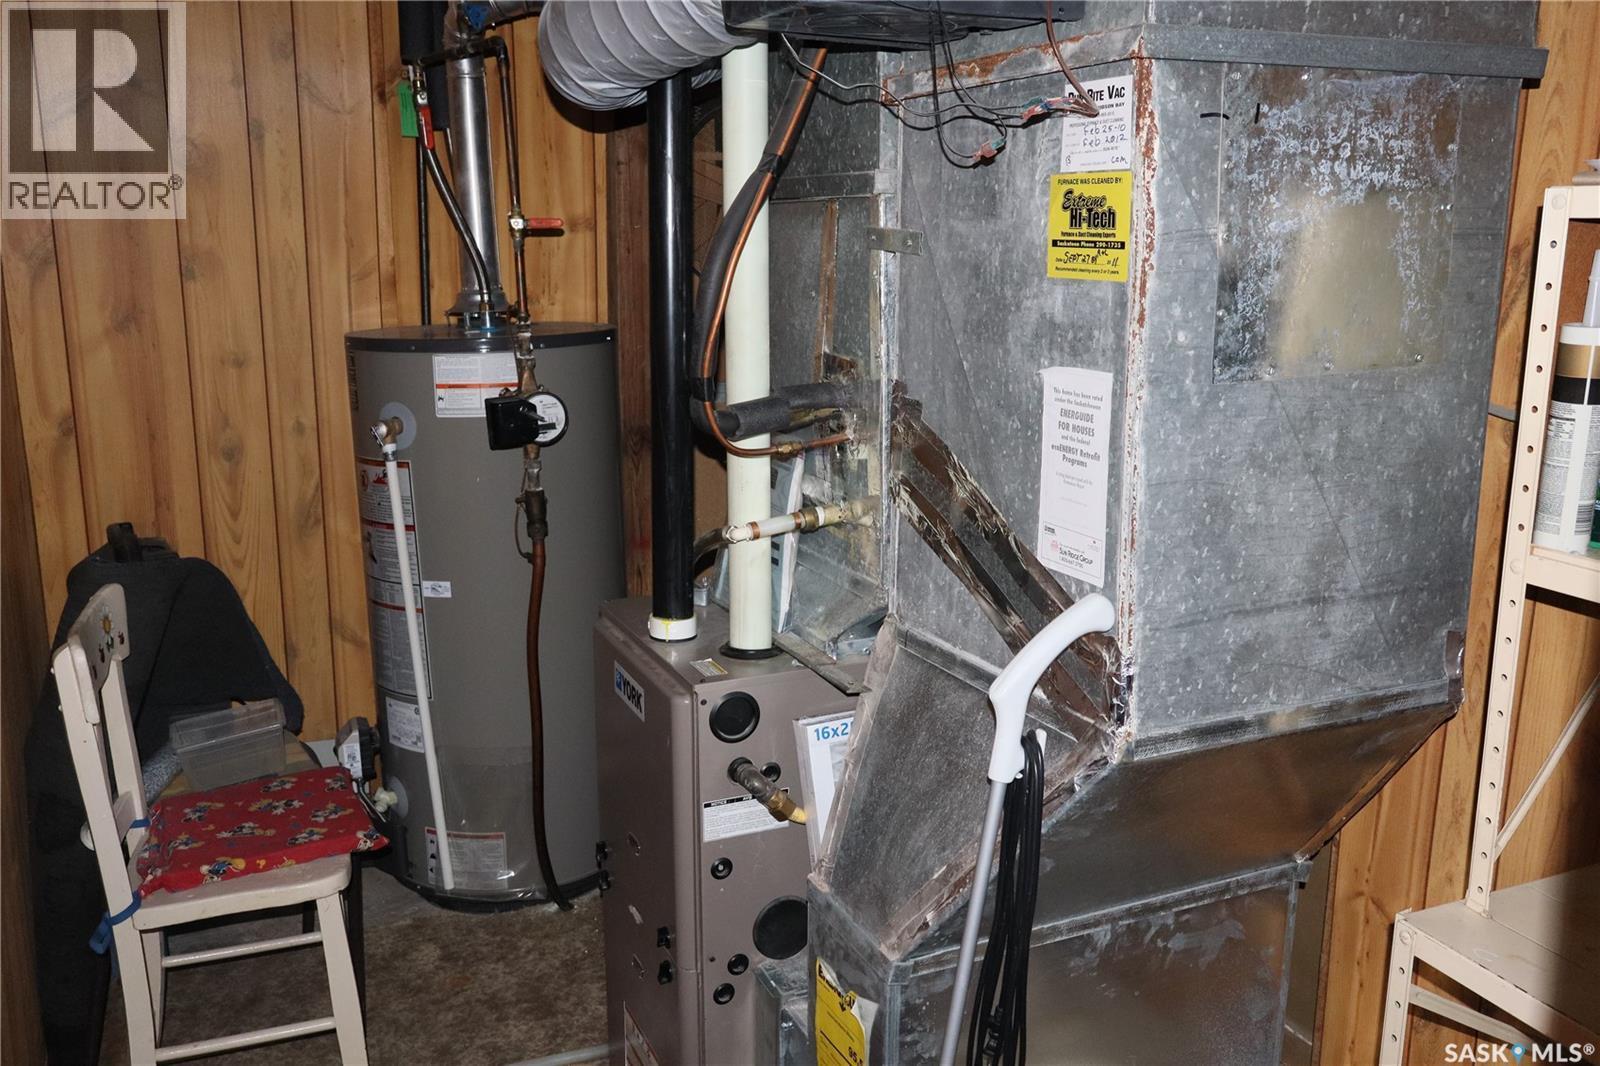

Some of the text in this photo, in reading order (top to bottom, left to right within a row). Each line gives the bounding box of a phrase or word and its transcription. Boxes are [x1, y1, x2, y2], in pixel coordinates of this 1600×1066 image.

[1107, 85, 1126, 99] VAC
[1105, 133, 1128, 144] 2012
[1057, 178, 1079, 186] FURNACE
[1091, 177, 1114, 185] CLEANED
[1062, 188, 1107, 212] Extreme
[1069, 206, 1117, 230] Hi-Tech
[1063, 251, 1082, 264] SEPT
[1060, 408, 1095, 423] ENERGUIDE
[1058, 420, 1095, 437] FOR HOUSES
[1051, 443, 1101, 462] ecoENERGY Retrofit
[1062, 453, 1088, 468] Programs
[622, 675, 643, 714] YORK
[814, 722, 853, 741] 16x2
